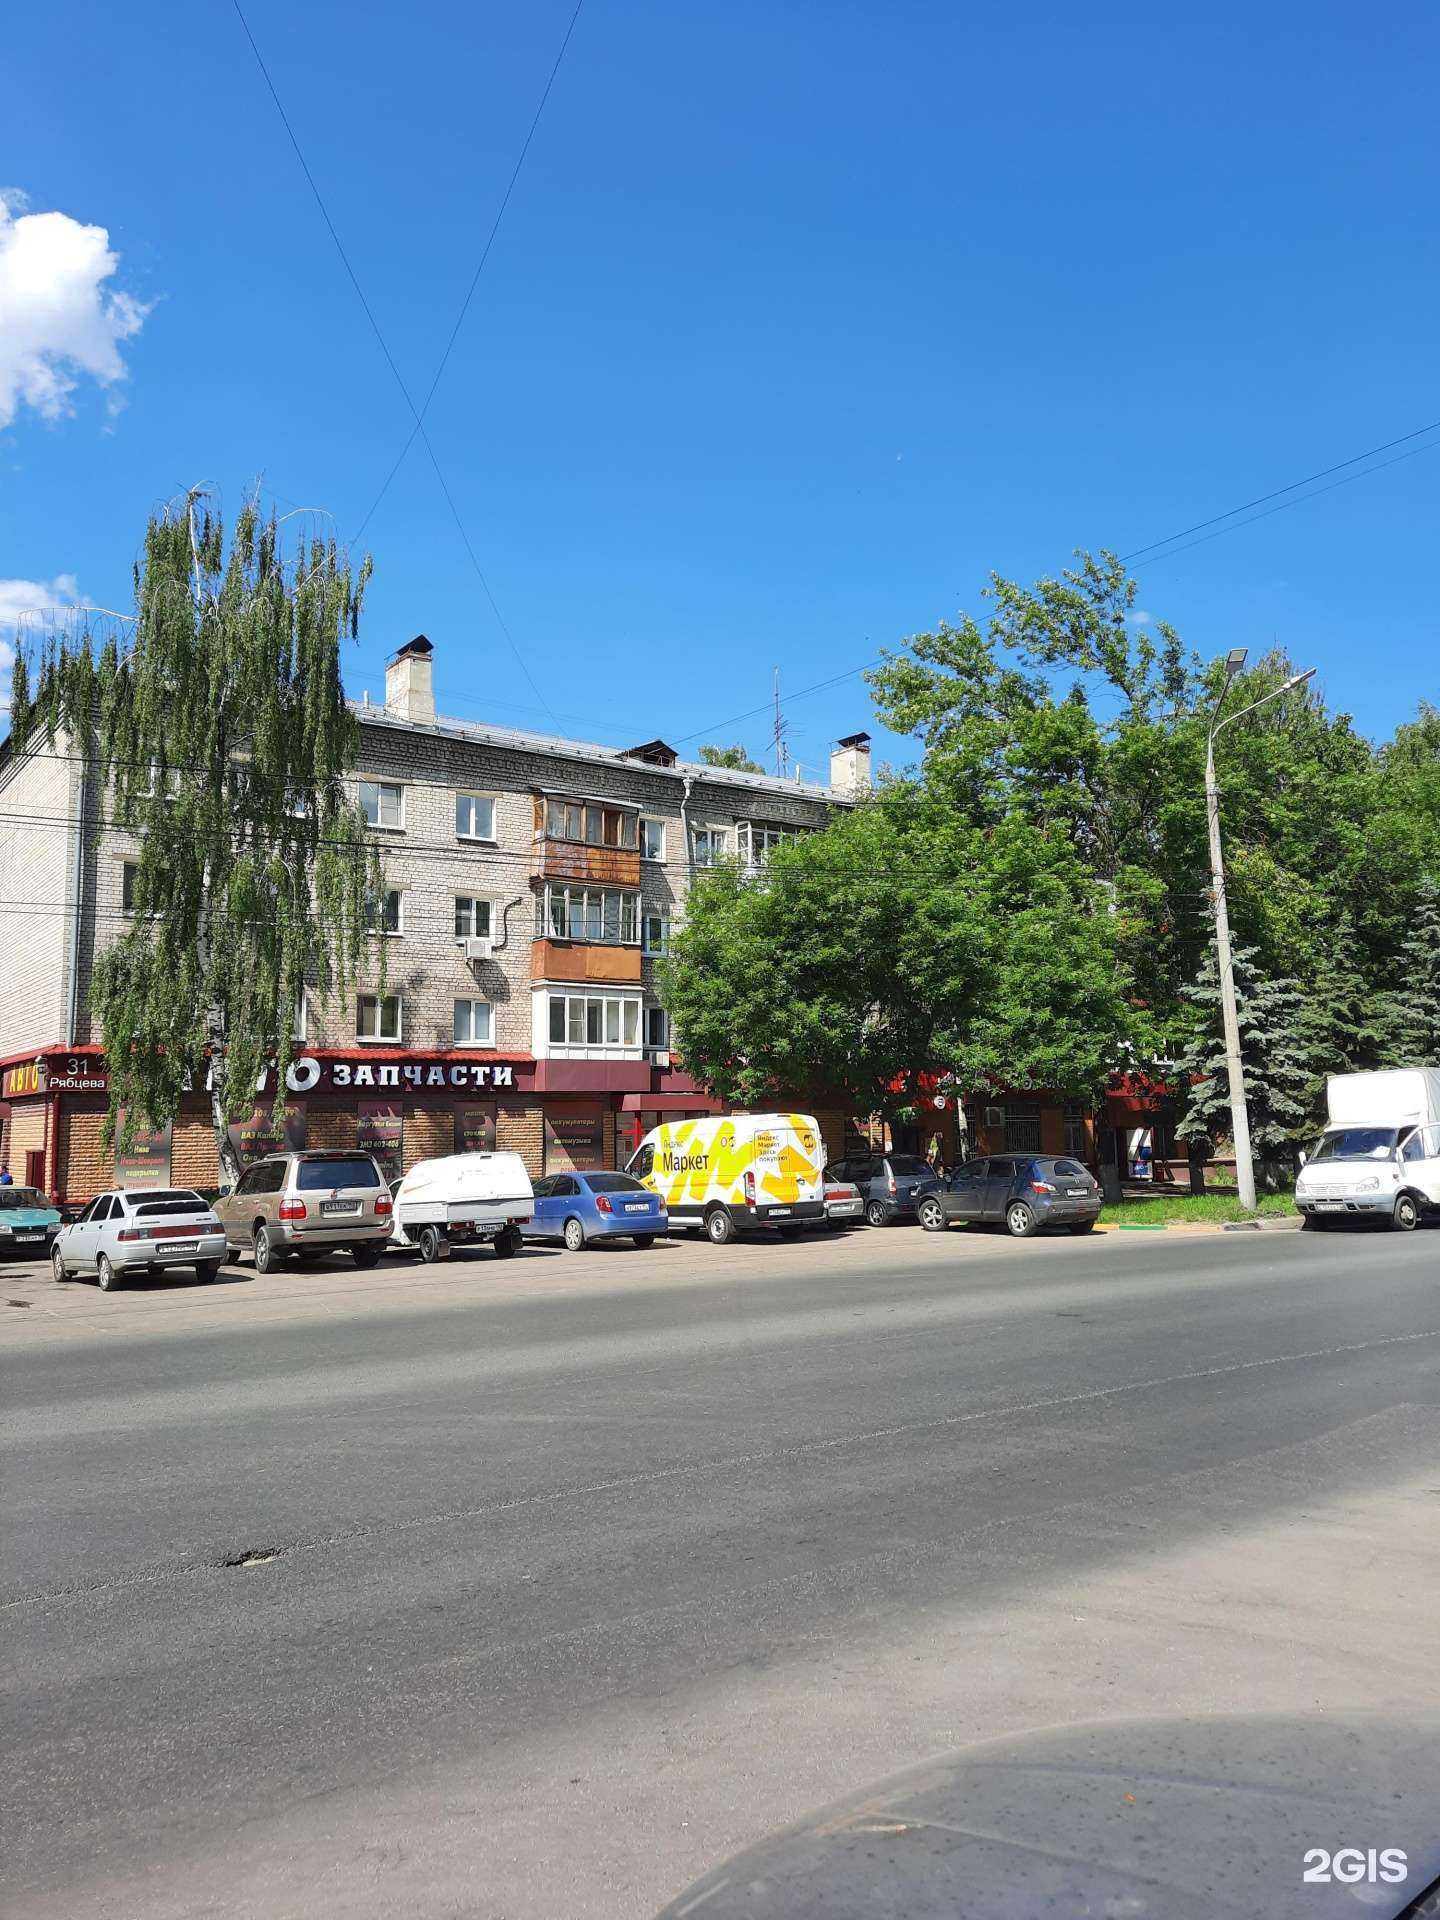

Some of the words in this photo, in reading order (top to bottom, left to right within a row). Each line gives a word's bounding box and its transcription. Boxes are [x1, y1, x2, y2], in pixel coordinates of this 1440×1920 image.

[66, 1058, 89, 1075] 31
[333, 1064, 513, 1086] ЗАПЧАСТИ
[9, 1064, 39, 1092] АВТО
[49, 1077, 105, 1090] Рябцева
[240, 1131, 256, 1140] ВАЗ
[663, 1152, 709, 1173] Маркет
